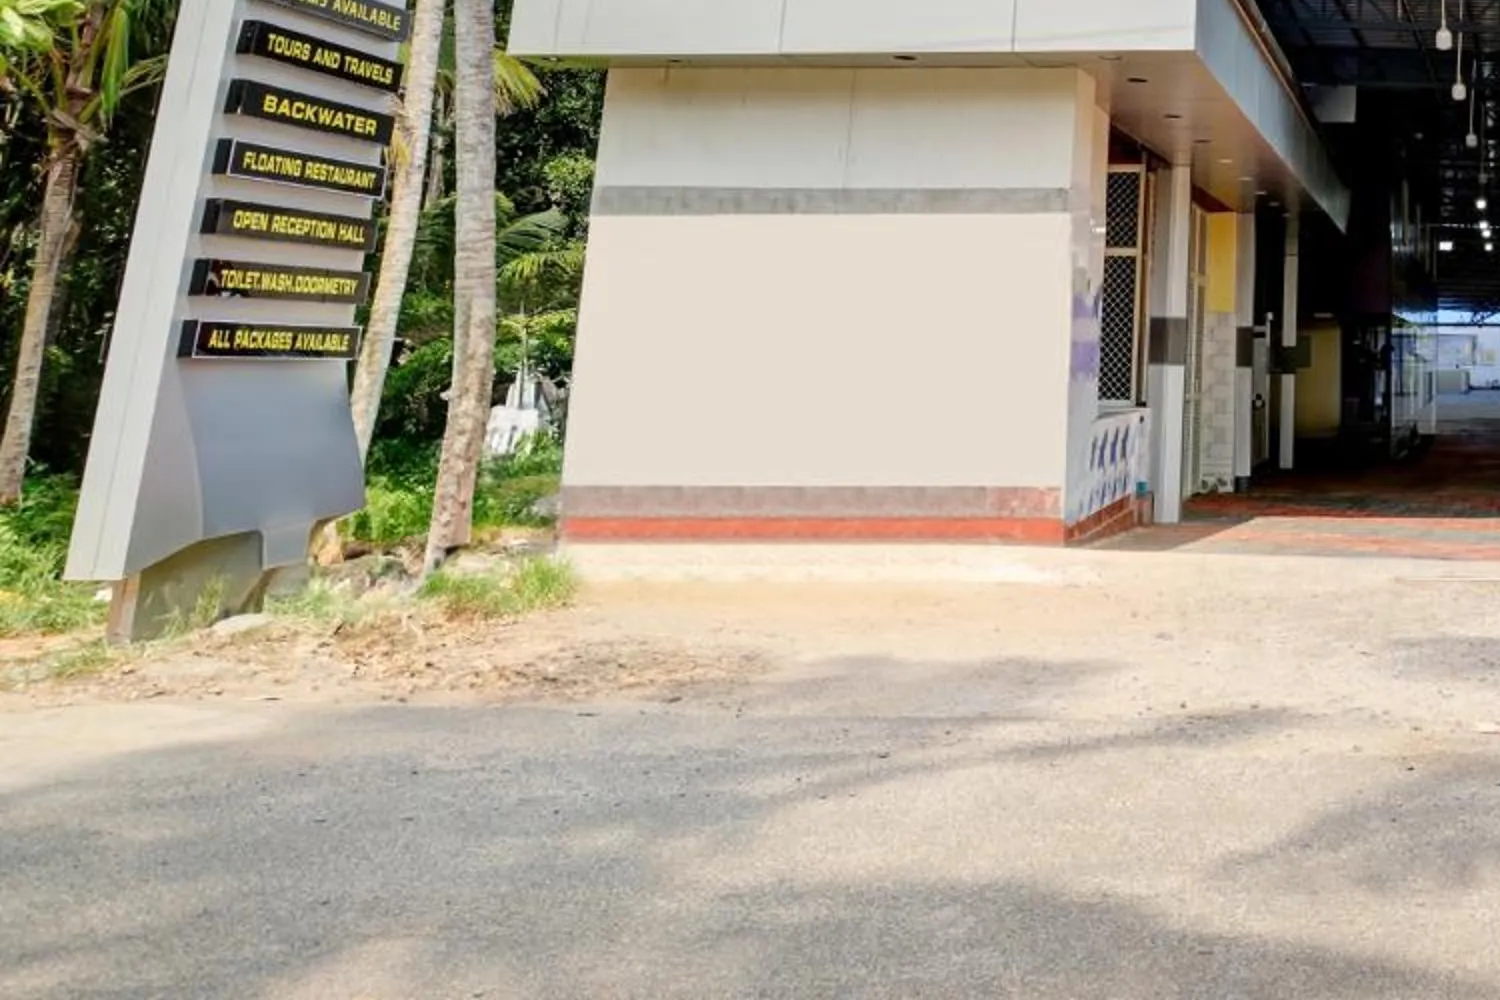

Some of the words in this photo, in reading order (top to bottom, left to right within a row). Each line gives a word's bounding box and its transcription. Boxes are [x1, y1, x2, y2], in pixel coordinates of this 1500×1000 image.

[267, 34, 311, 61] TOURS
[313, 48, 341, 70] AND
[343, 57, 393, 84] TRAVELS
[263, 95, 377, 136] BACKWATER
[243, 151, 303, 178] FLOATING
[303, 161, 377, 189] RESTAURANT
[233, 209, 269, 231] OPEN
[271, 213, 337, 238] RECEPTION
[338, 220, 365, 243] HALL
[208, 328, 231, 349] ALL
[233, 329, 294, 351] PACKAGES
[295, 331, 349, 351] AVAILABLE
